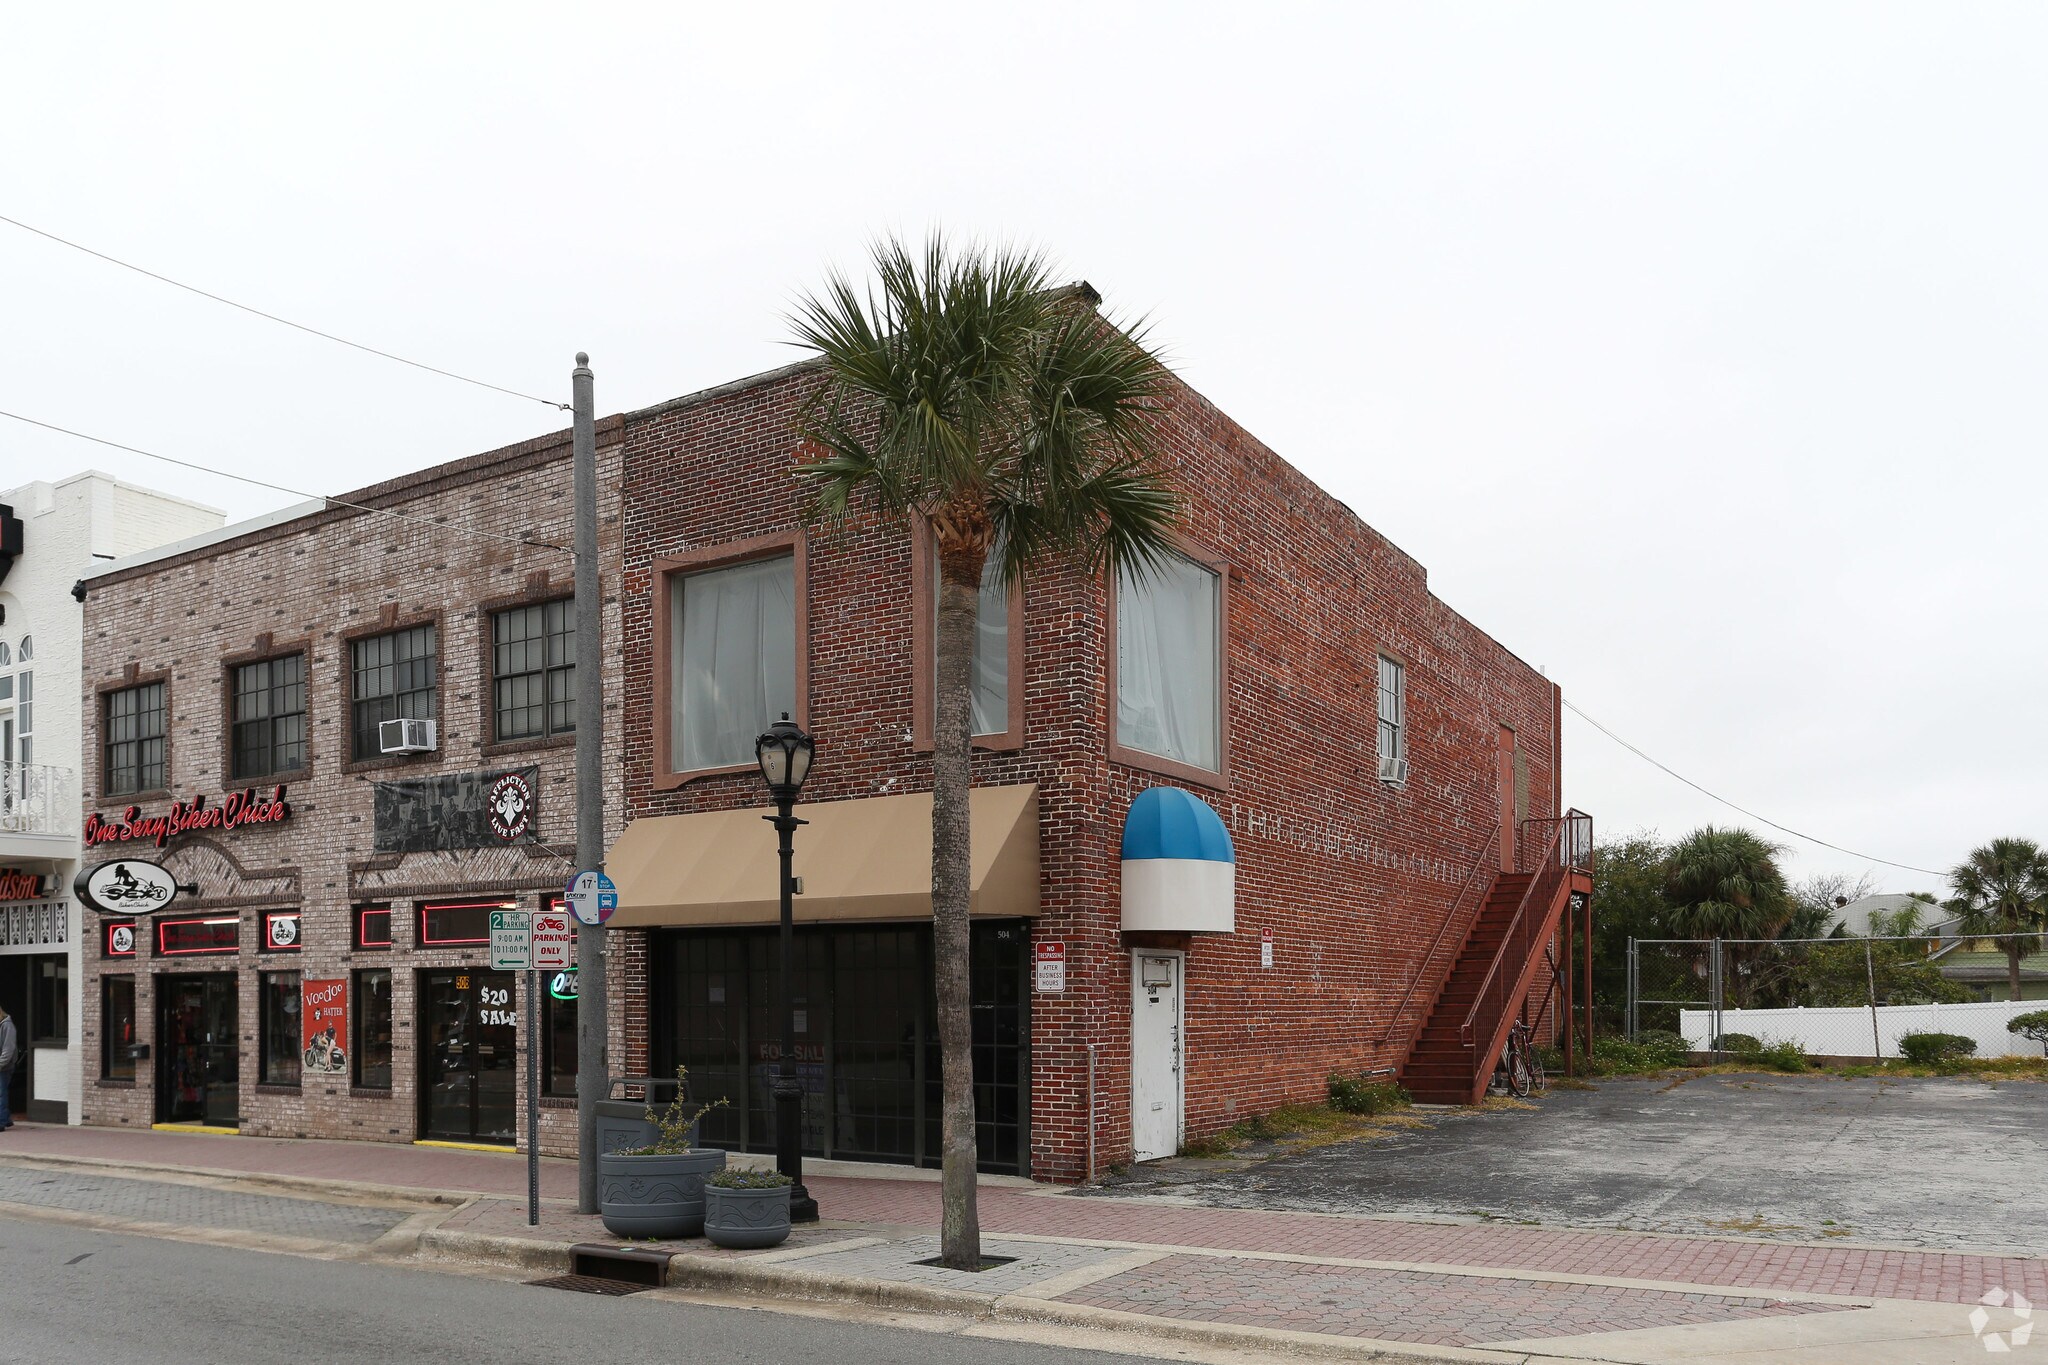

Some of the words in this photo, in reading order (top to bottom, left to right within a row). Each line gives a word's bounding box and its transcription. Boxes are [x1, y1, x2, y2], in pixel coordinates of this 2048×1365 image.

[490, 775, 530, 803] AFFLICTION
[84, 812, 118, 846] One
[119, 805, 166, 848] Sexy
[166, 794, 221, 836] Biker
[223, 784, 286, 830] Chick
[491, 817, 508, 837] LIVE
[510, 815, 529, 837] FAST
[582, 879, 593, 889] 17
[492, 914, 502, 929] 2
[503, 920, 529, 929] PARKING
[497, 934, 513, 942] 9:00
[514, 934, 523, 942] AM
[533, 934, 569, 942] PARKING
[997, 930, 1010, 939] 504
[493, 945, 501, 953] TO
[502, 945, 518, 953] 11:00
[541, 946, 561, 954] ONLY
[553, 972, 578, 994] OPE
[480, 985, 509, 1006] $20
[323, 1007, 343, 1016] HATTER
[480, 1009, 517, 1027] SALE
[793, 1044, 825, 1061] SAL
